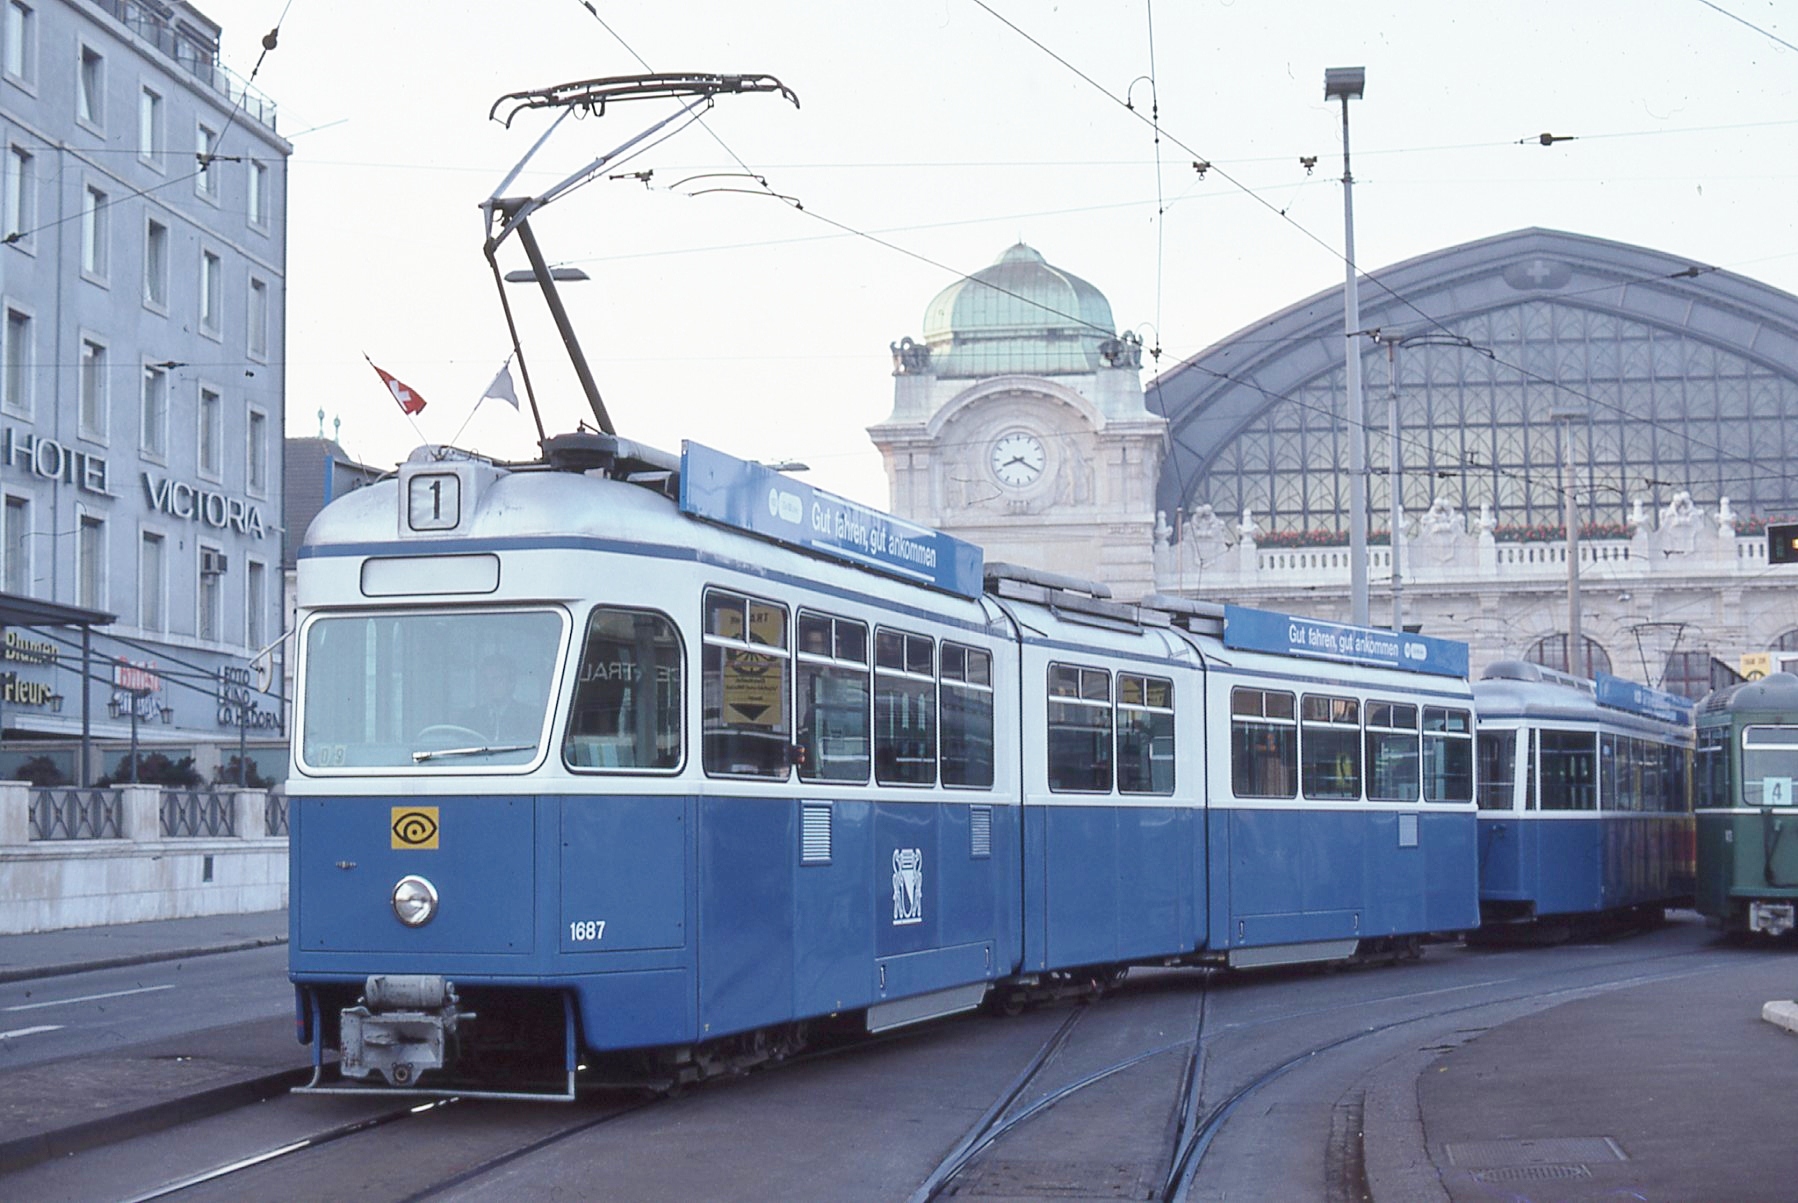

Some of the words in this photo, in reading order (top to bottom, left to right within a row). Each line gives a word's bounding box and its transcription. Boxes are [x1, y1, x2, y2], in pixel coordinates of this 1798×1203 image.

[7, 427, 124, 499] HOTEL
[143, 472, 266, 539] VICTORIA
[429, 480, 441, 519] 1
[811, 502, 831, 534] Gut
[835, 511, 868, 553] fahren,
[870, 527, 886, 555] gut
[888, 535, 936, 568] ankommen
[1288, 624, 1306, 644] Gut
[1308, 627, 1338, 651] fahren,
[1339, 633, 1353, 653] gut
[1355, 637, 1399, 657] ankommen
[5, 671, 52, 705] Fleurs
[1772, 782, 1782, 800] 4
[569, 921, 606, 940] 1687
